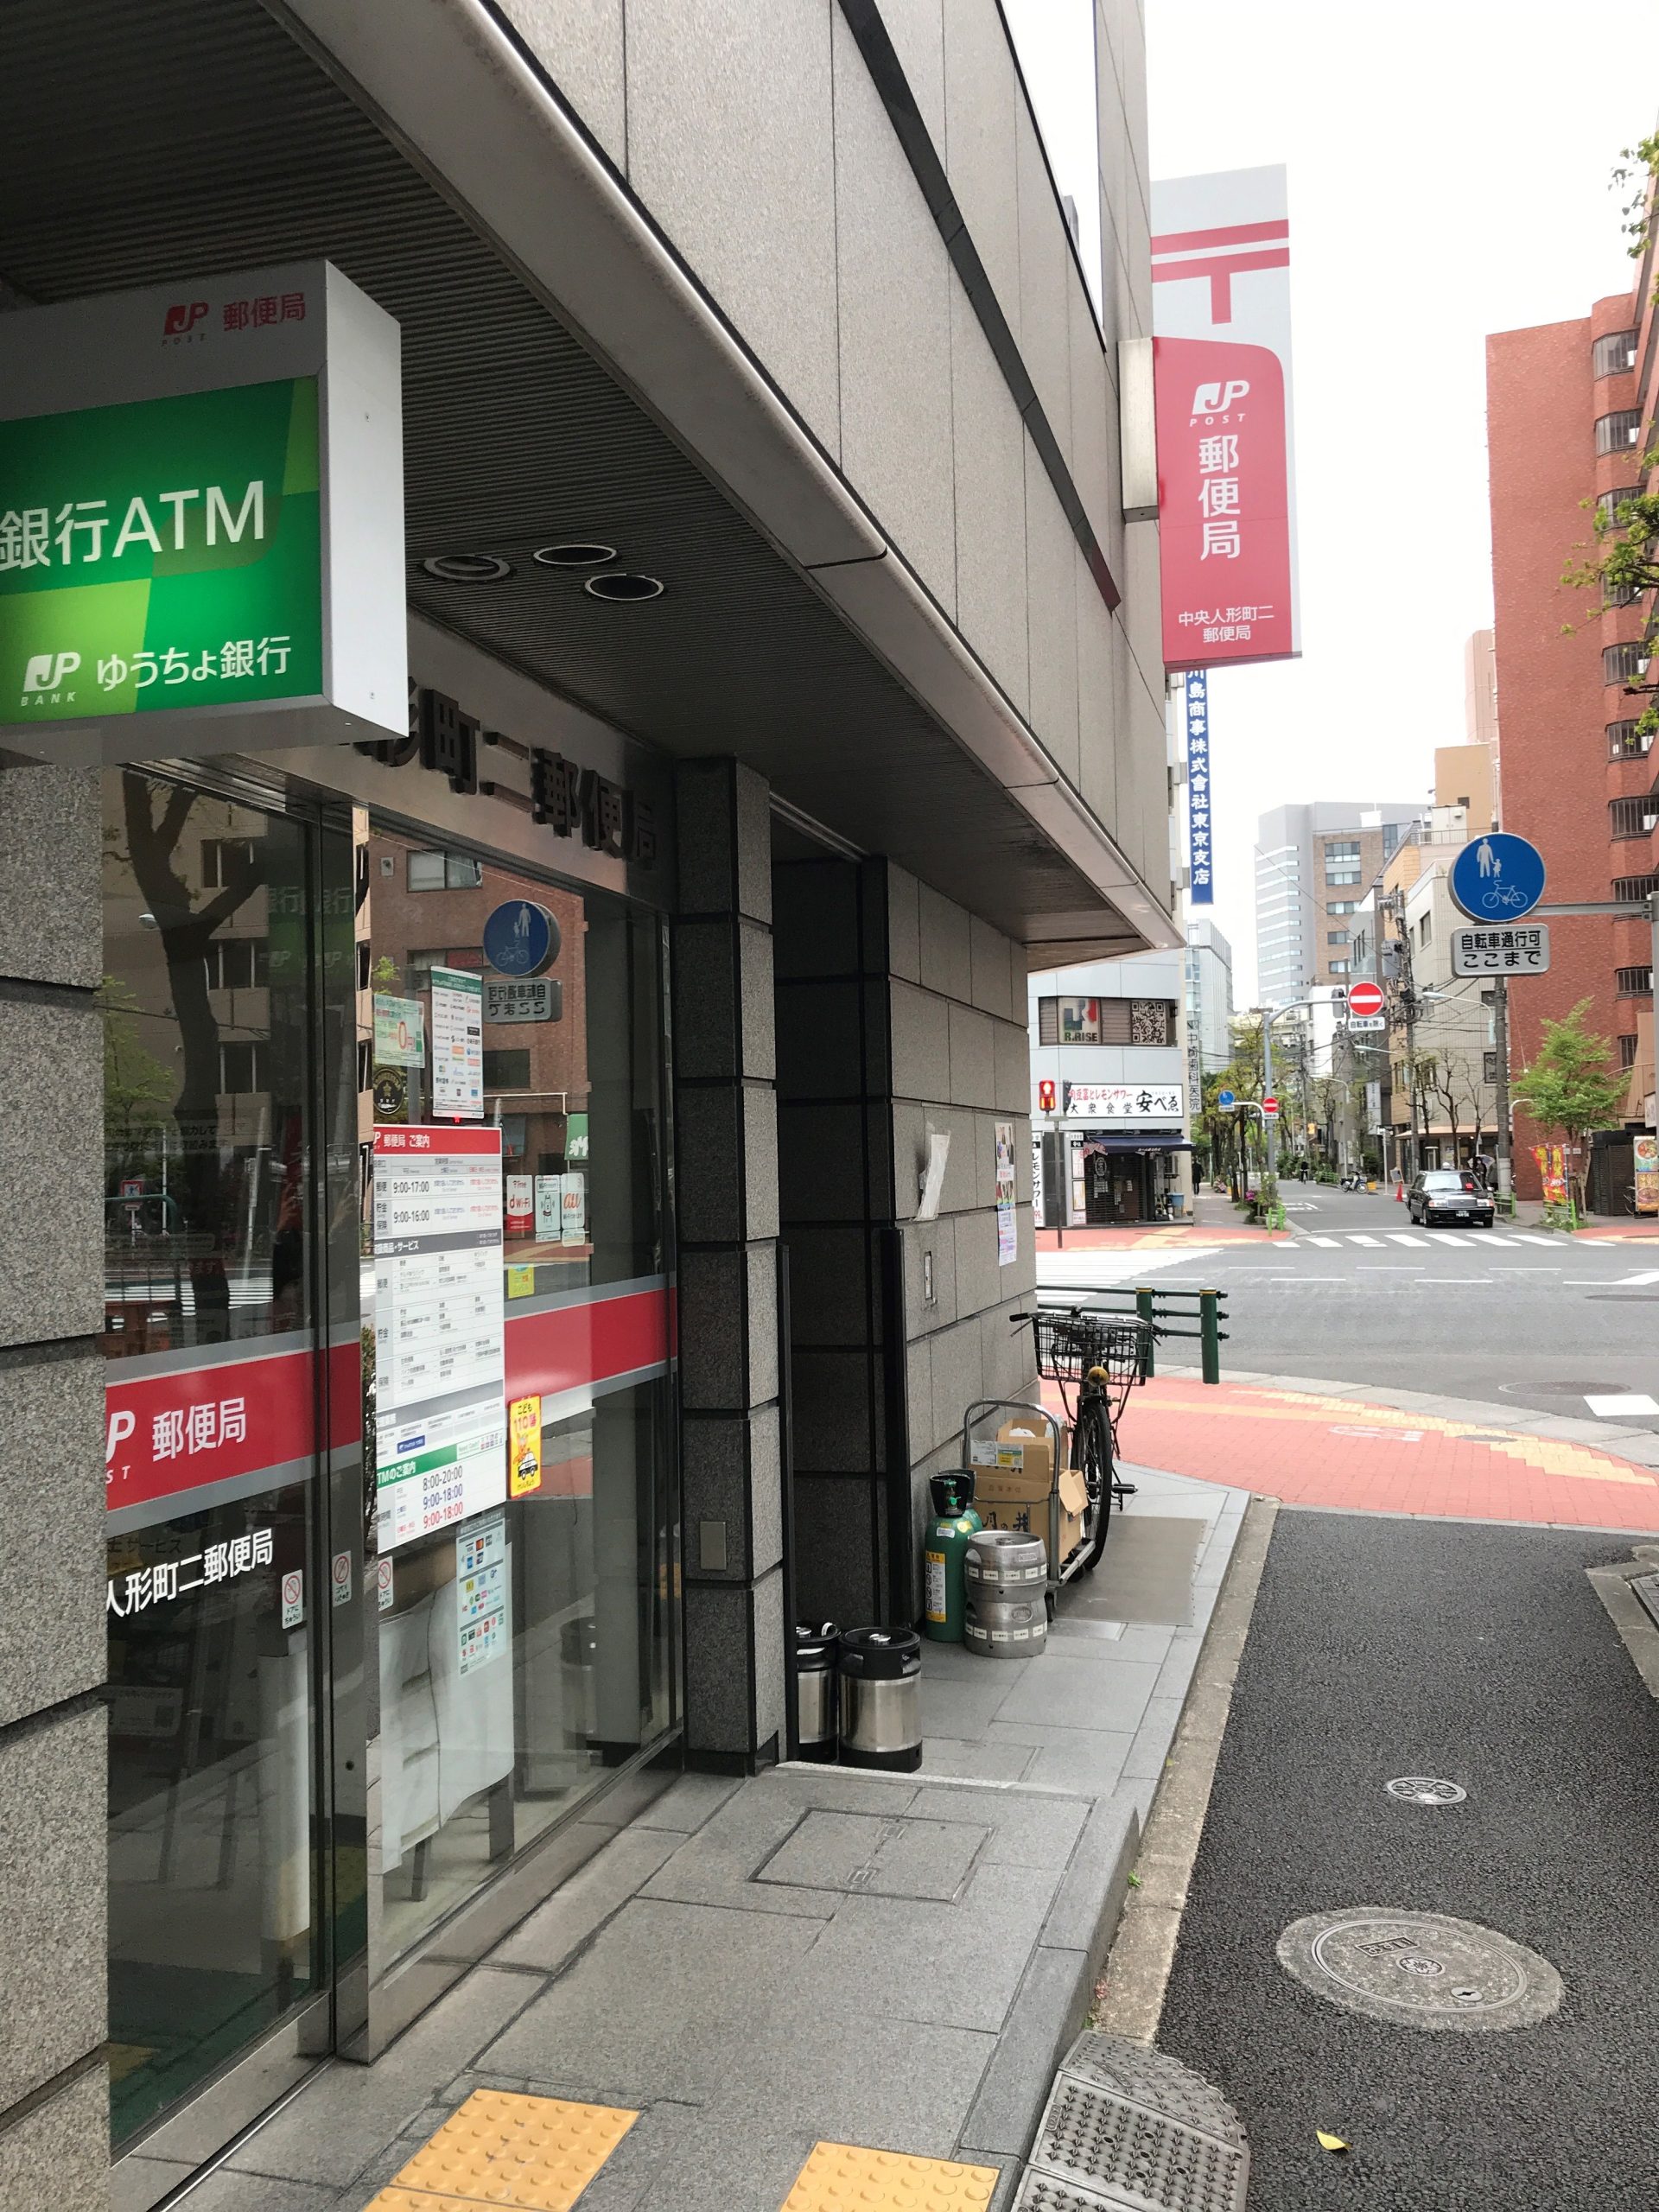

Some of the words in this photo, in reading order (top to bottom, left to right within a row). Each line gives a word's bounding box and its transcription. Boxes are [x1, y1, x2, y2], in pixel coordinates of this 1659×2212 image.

[223, 291, 306, 332] 郵便局
[1192, 379, 1250, 416] JP
[1189, 412, 1246, 428] POST
[1198, 434, 1242, 562] 郵便局
[0, 480, 265, 571] 銀行ATM
[1178, 605, 1274, 626] 中央人形町二
[1202, 626, 1252, 644] 郵便局
[23, 652, 82, 692] JP
[97, 635, 292, 692] ゆうちょ銀行
[20, 692, 77, 707] BANK
[1461, 930, 1541, 950] 自転車通行可
[1463, 950, 1541, 969] ここまで
[1064, 1032, 1098, 1042] R.RISE
[1070, 1102, 1134, 1115] 大衆食堂
[384, 1134, 406, 1147] 郵便局
[409, 1135, 430, 1148] ご案内
[393, 1181, 429, 1194] 9:00-17:00
[393, 1210, 429, 1224] 9:00-16:00
[518, 1402, 532, 1415] こども
[152, 1397, 247, 1463] 郵便局
[423, 1465, 463, 1491] 8:00-20:00
[423, 1484, 463, 1510] 9:00-18:00
[423, 1502, 464, 1529] 9:00-18:00
[106, 1529, 274, 1618] 人形町二郵便局
